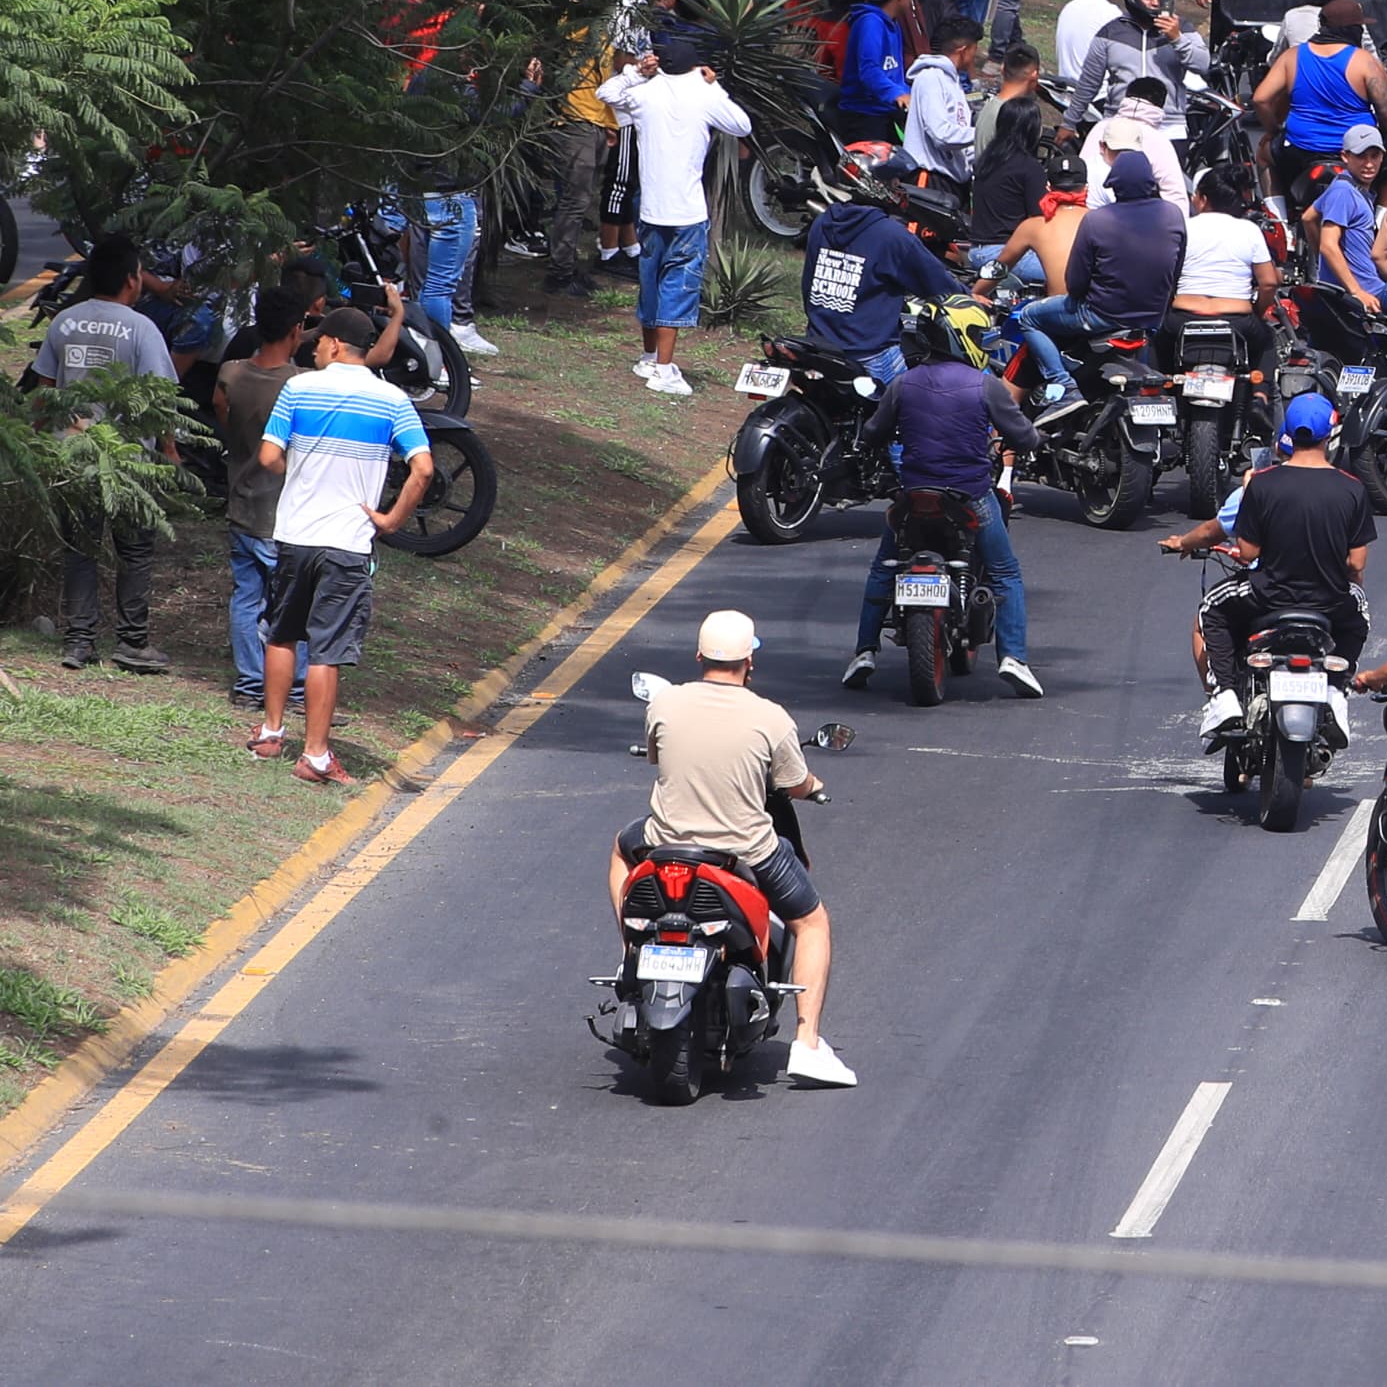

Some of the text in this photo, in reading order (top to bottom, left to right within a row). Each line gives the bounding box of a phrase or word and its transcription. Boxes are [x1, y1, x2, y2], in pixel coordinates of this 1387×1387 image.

[817, 254, 842, 268] New
[814, 265, 861, 287] HARBOR
[811, 278, 857, 300] SCHOOL
[78, 320, 132, 340] cemix
